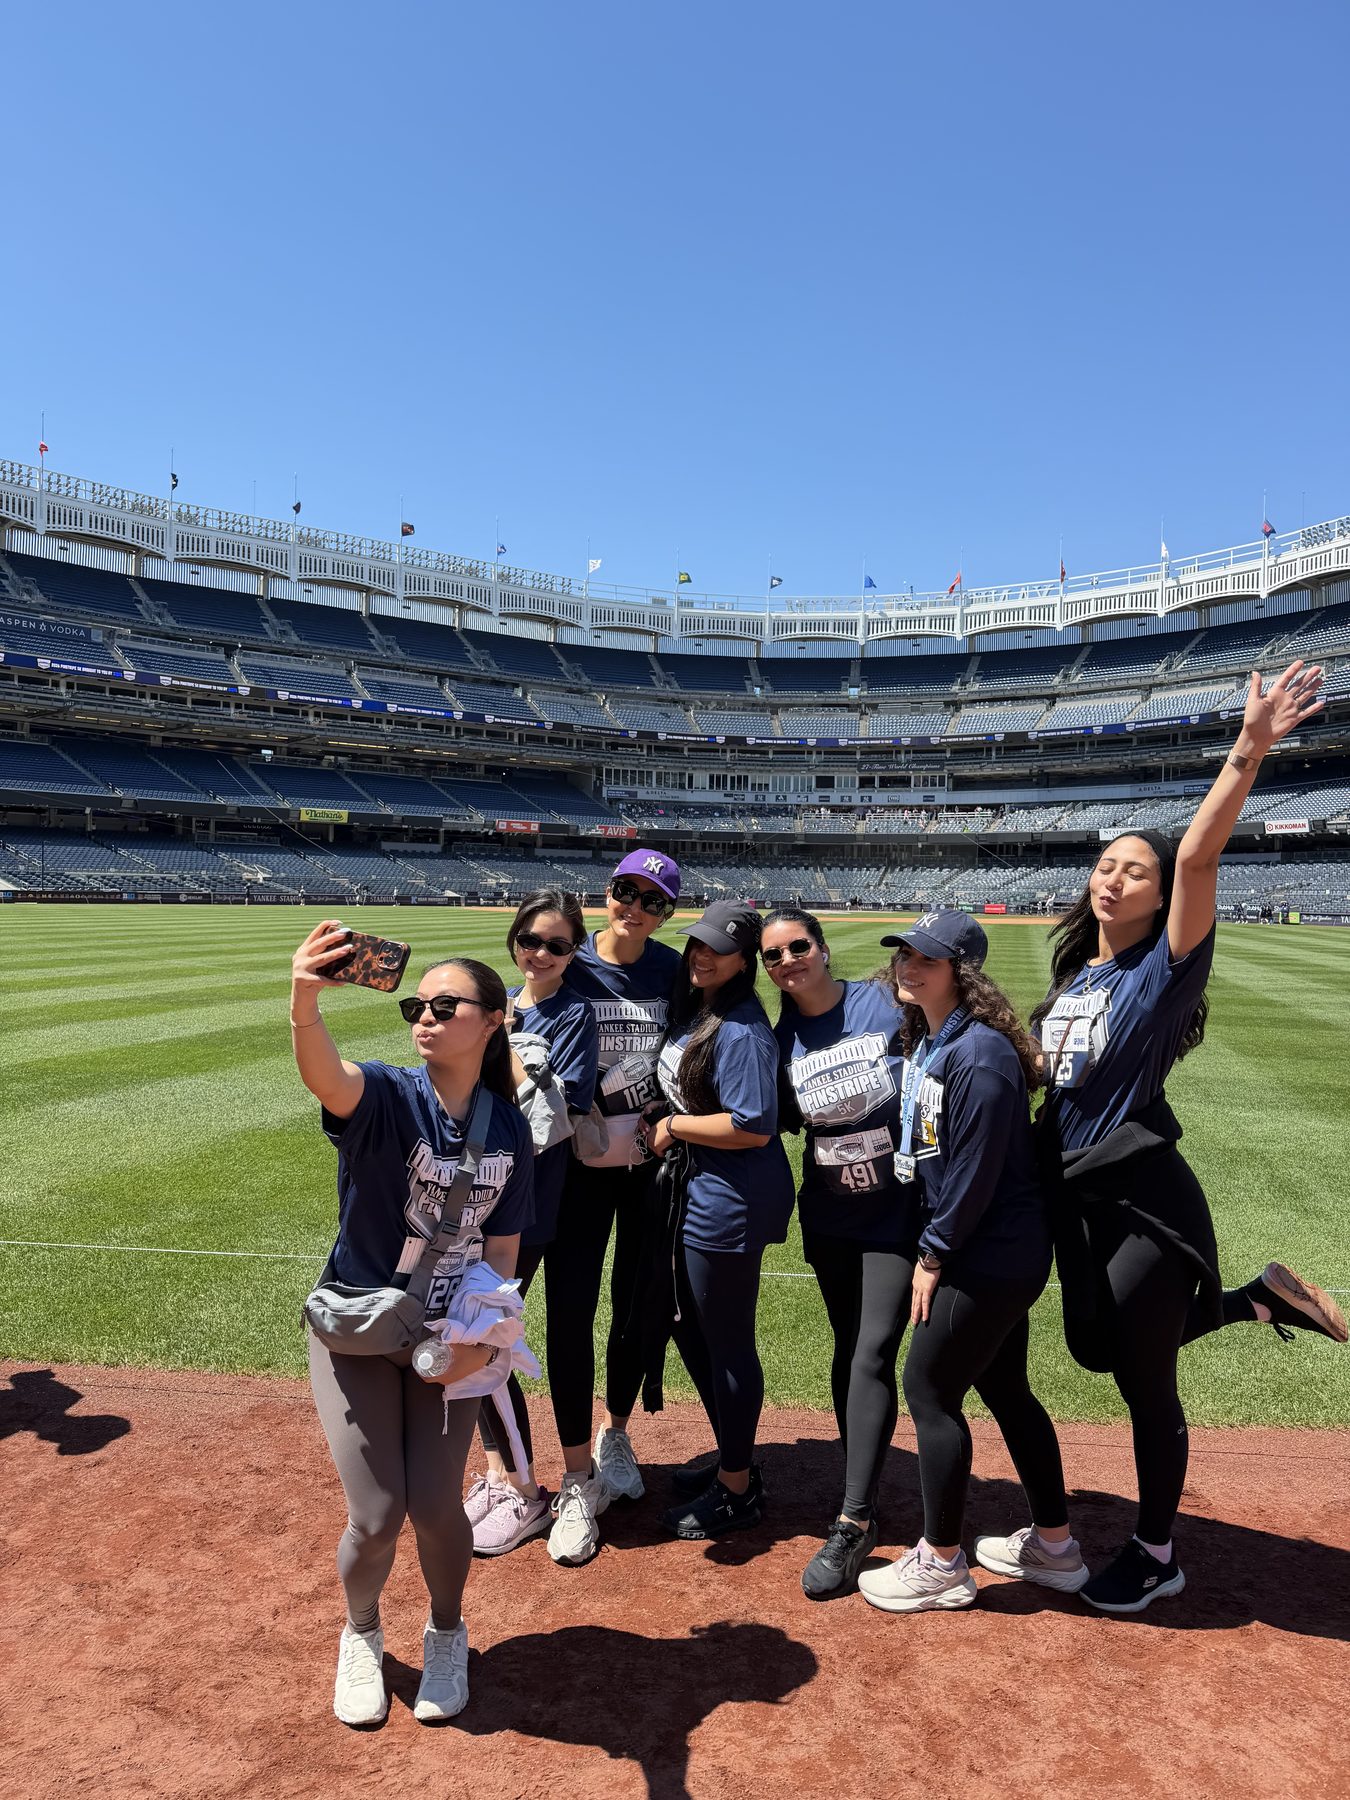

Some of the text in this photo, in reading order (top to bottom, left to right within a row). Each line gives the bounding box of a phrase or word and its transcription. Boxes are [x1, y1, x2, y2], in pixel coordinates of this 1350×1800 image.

[0, 616, 86, 637] ASPEN VODKA
[908, 762, 941, 771] Champions
[305, 809, 343, 819] Nathan's
[605, 827, 628, 837] AVIS
[1274, 822, 1307, 830] KIKKOMAN
[643, 856, 665, 875] NY
[915, 912, 939, 928] NY
[626, 1023, 658, 1033] STADIUM
[598, 1036, 660, 1052] INSTRIPE
[803, 1060, 870, 1091] YANKEE STADIUM
[623, 1075, 658, 1110] 1123
[804, 1071, 881, 1112] PINSTRIPE
[836, 1101, 856, 1115] 5K
[840, 1160, 879, 1189] 491
[467, 1188, 496, 1203] ADIUM
